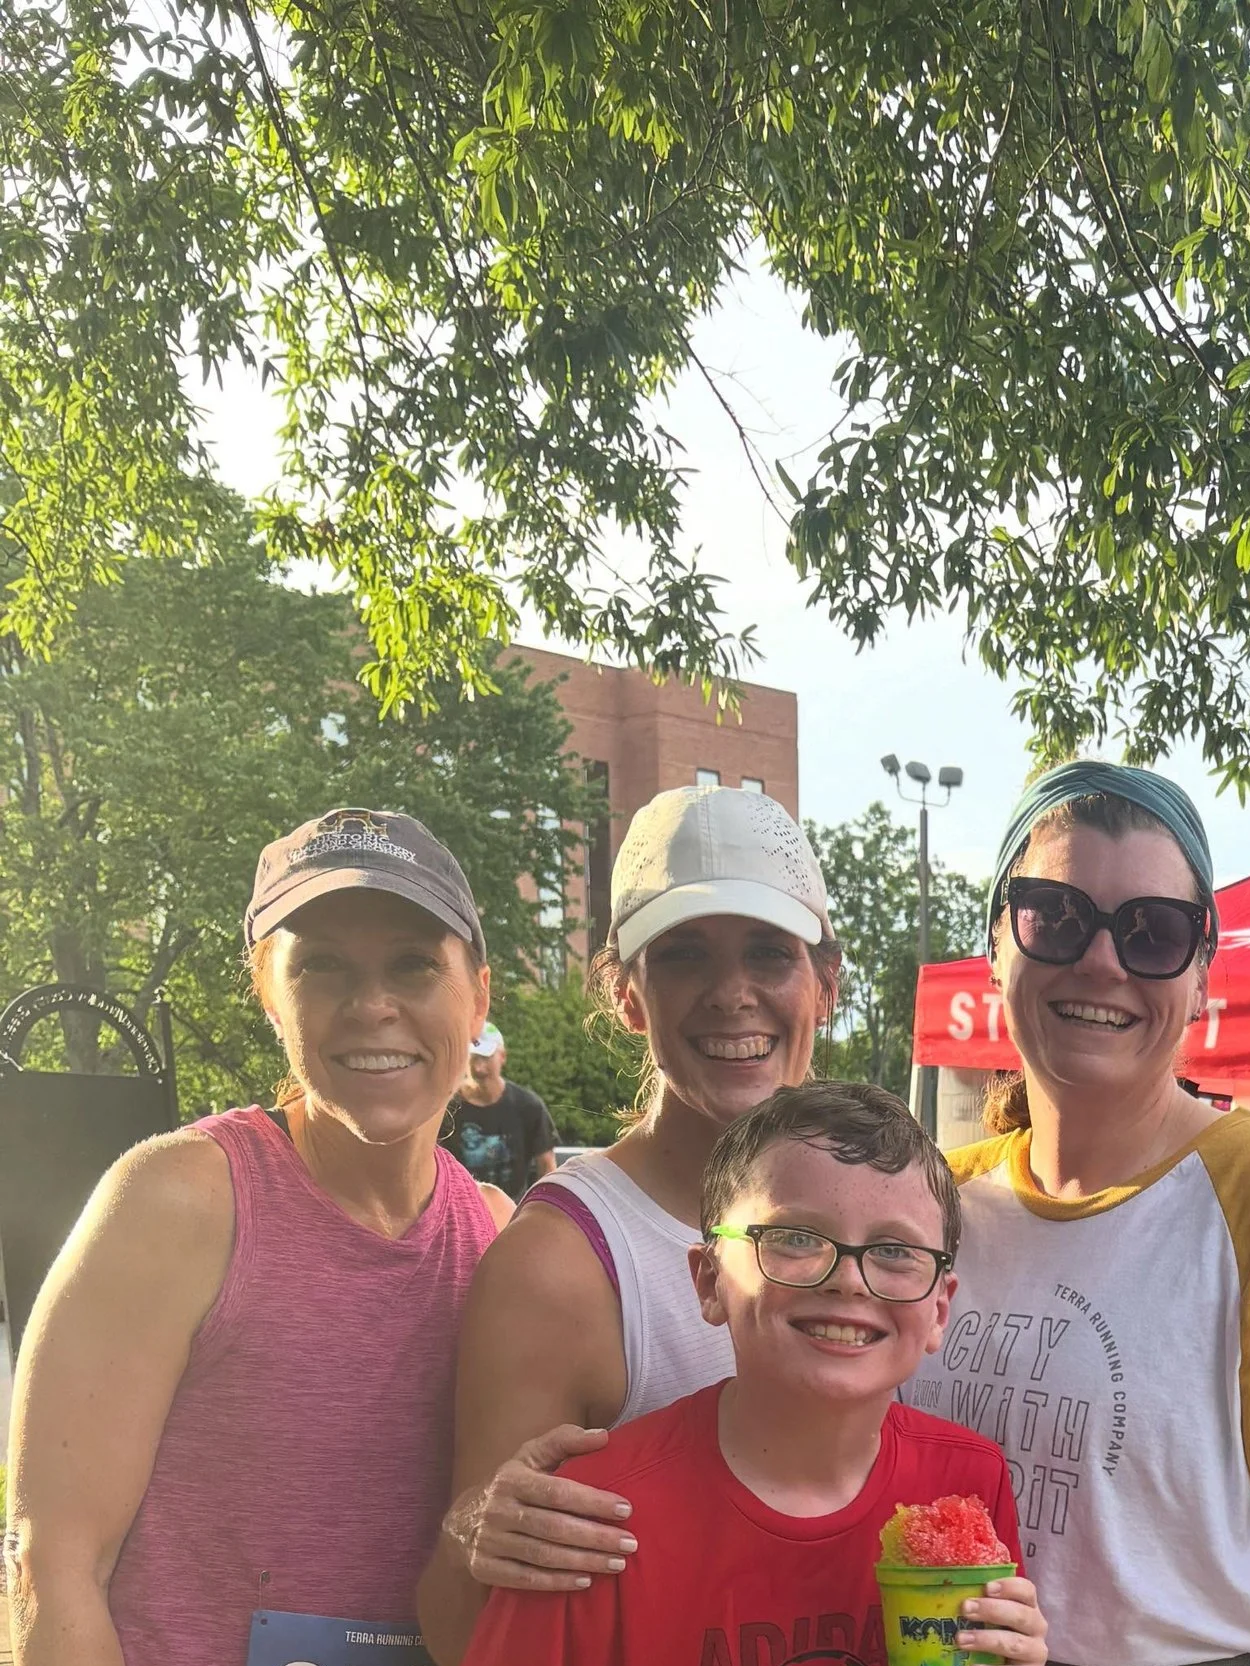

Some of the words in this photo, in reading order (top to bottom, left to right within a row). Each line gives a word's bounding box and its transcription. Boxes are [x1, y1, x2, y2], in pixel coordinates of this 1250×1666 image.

[1053, 1283, 1092, 1315] TERRA
[943, 1310, 1071, 1382] CITY
[1089, 1311, 1124, 1384] RUNNING
[951, 1380, 1090, 1462] WITH
[1101, 1391, 1127, 1477] COMPANY
[345, 1630, 375, 1646] TERRA
[376, 1632, 415, 1647] RUNNING
